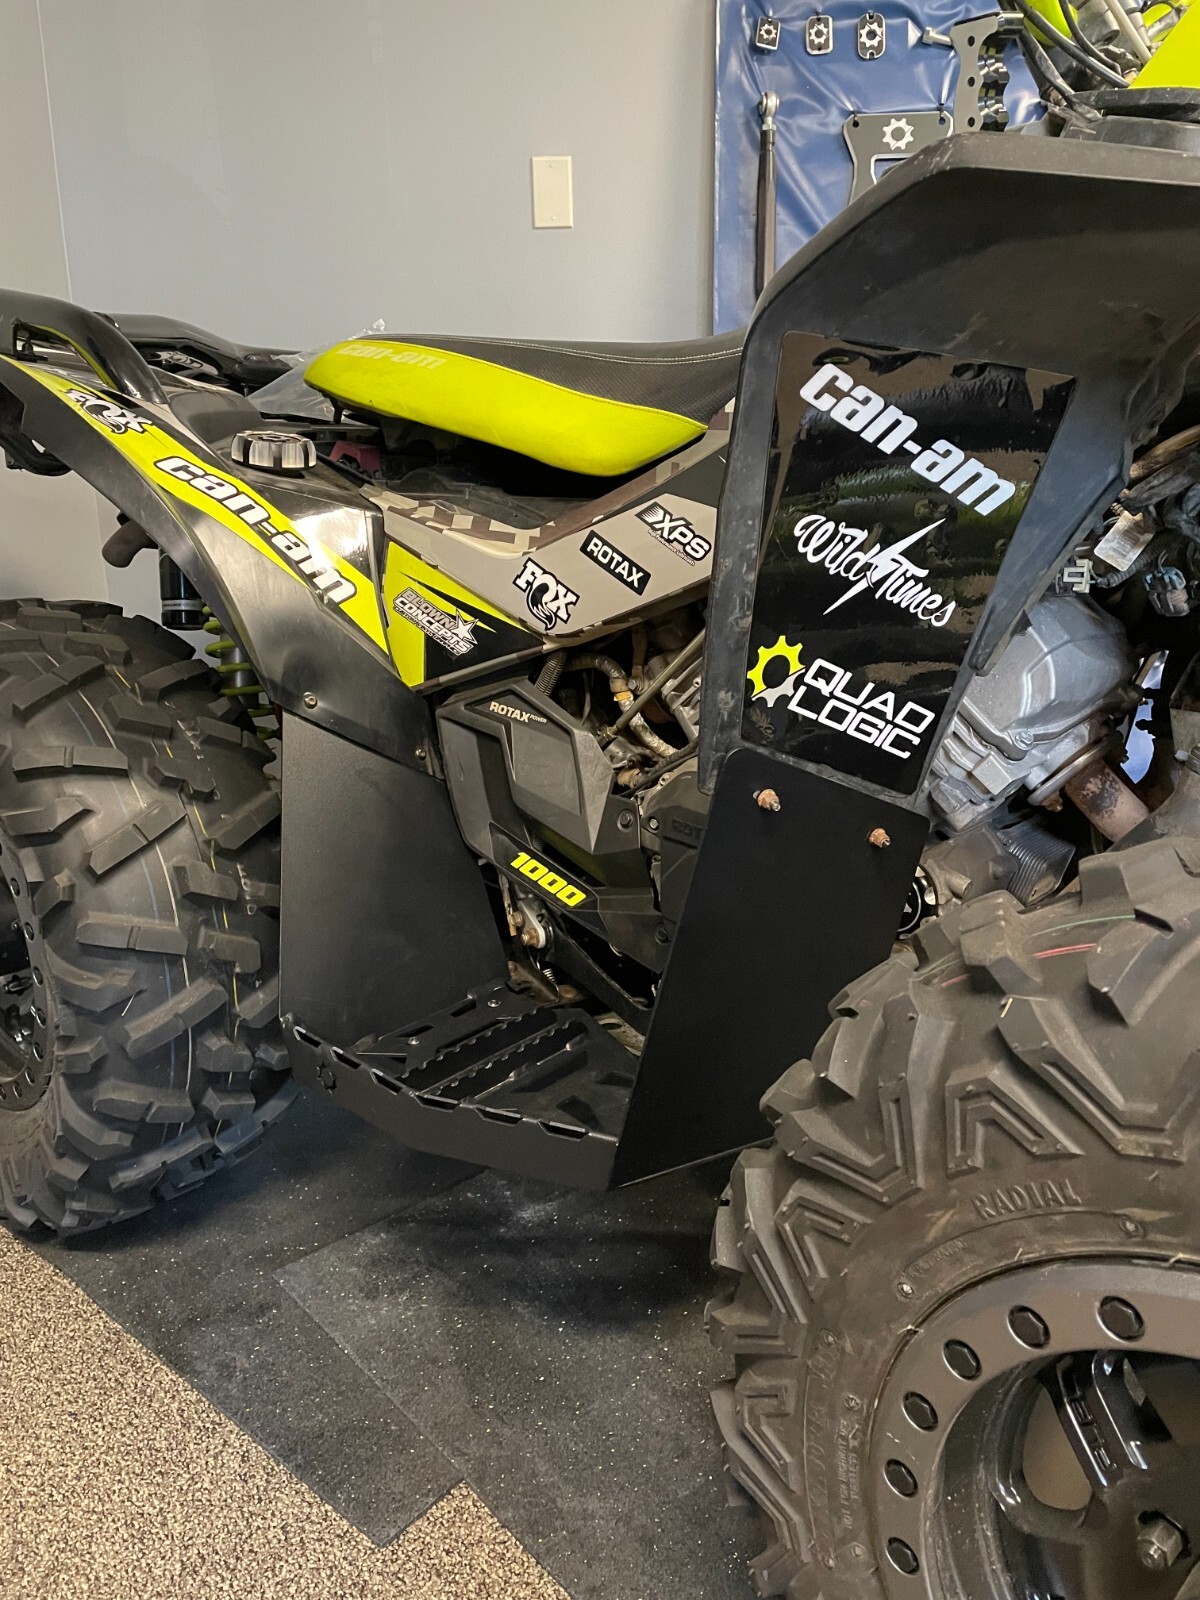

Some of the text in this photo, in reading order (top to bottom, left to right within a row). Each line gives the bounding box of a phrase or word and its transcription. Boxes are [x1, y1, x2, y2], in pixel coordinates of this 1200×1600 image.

[336, 344, 447, 369] can-am
[64, 388, 153, 434] FOX
[800, 363, 1016, 517] can-am
[154, 456, 357, 603] can-am
[651, 512, 711, 560] XPS
[586, 536, 644, 588] ROTAX
[793, 514, 956, 627] Wild Times
[401, 590, 456, 629] BLOWN
[513, 558, 579, 630] FOX
[394, 597, 473, 652] CONCEPTS
[490, 701, 530, 723] ROTAX
[787, 685, 921, 759] LOGIC
[804, 658, 936, 734] QUAD
[510, 851, 587, 907] 1000
[971, 1178, 1082, 1220] RADIAL
